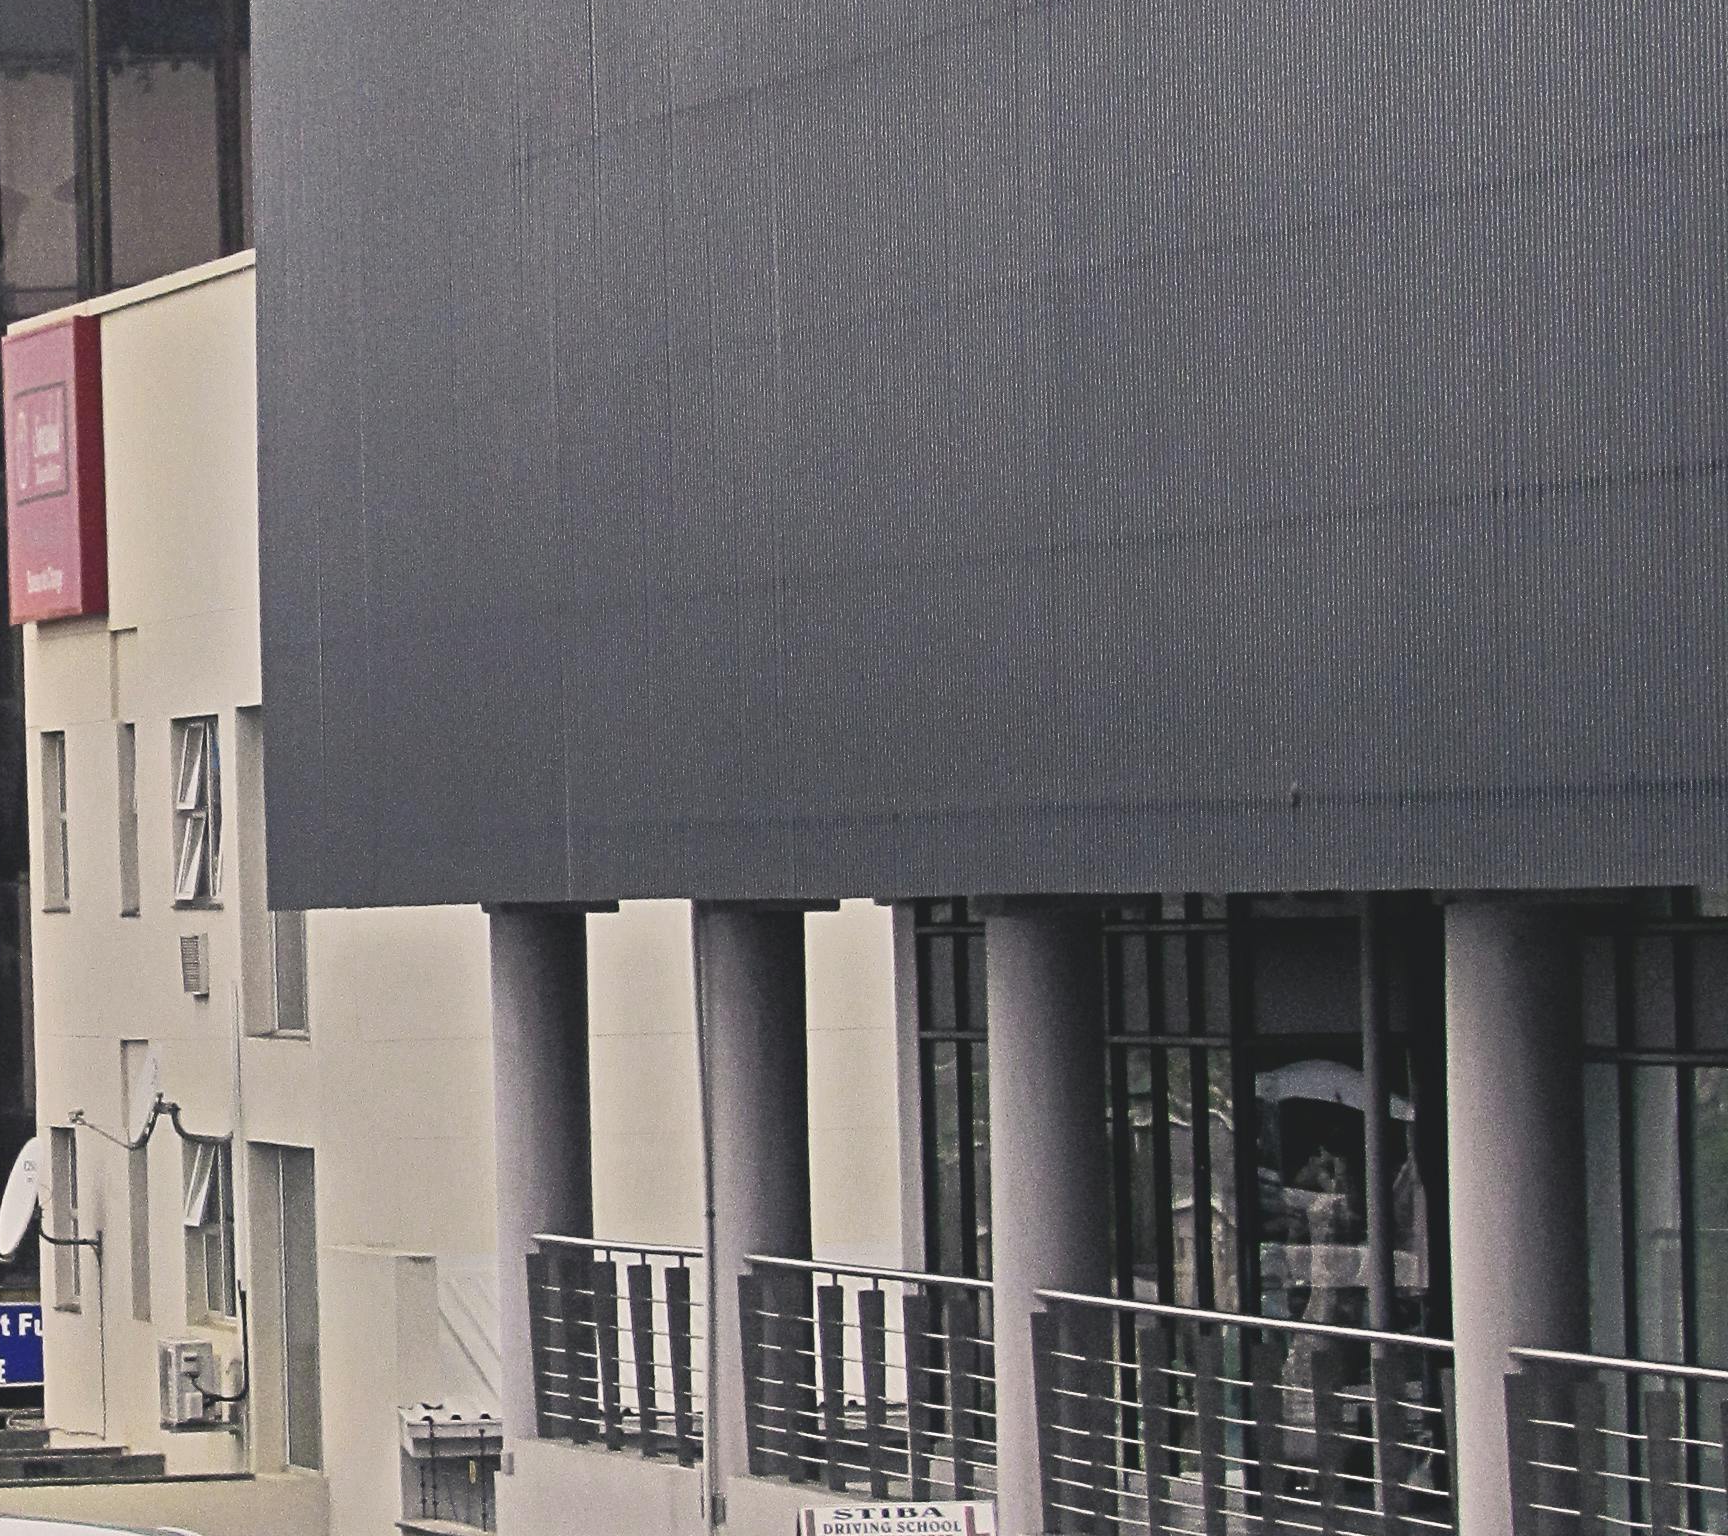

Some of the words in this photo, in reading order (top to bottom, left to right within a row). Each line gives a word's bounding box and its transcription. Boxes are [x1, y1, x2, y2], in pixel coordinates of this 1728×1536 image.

[833, 1506, 945, 1520] STIBA
[823, 1522, 891, 1535] DRIVING
[897, 1520, 961, 1533] SCHOOL
